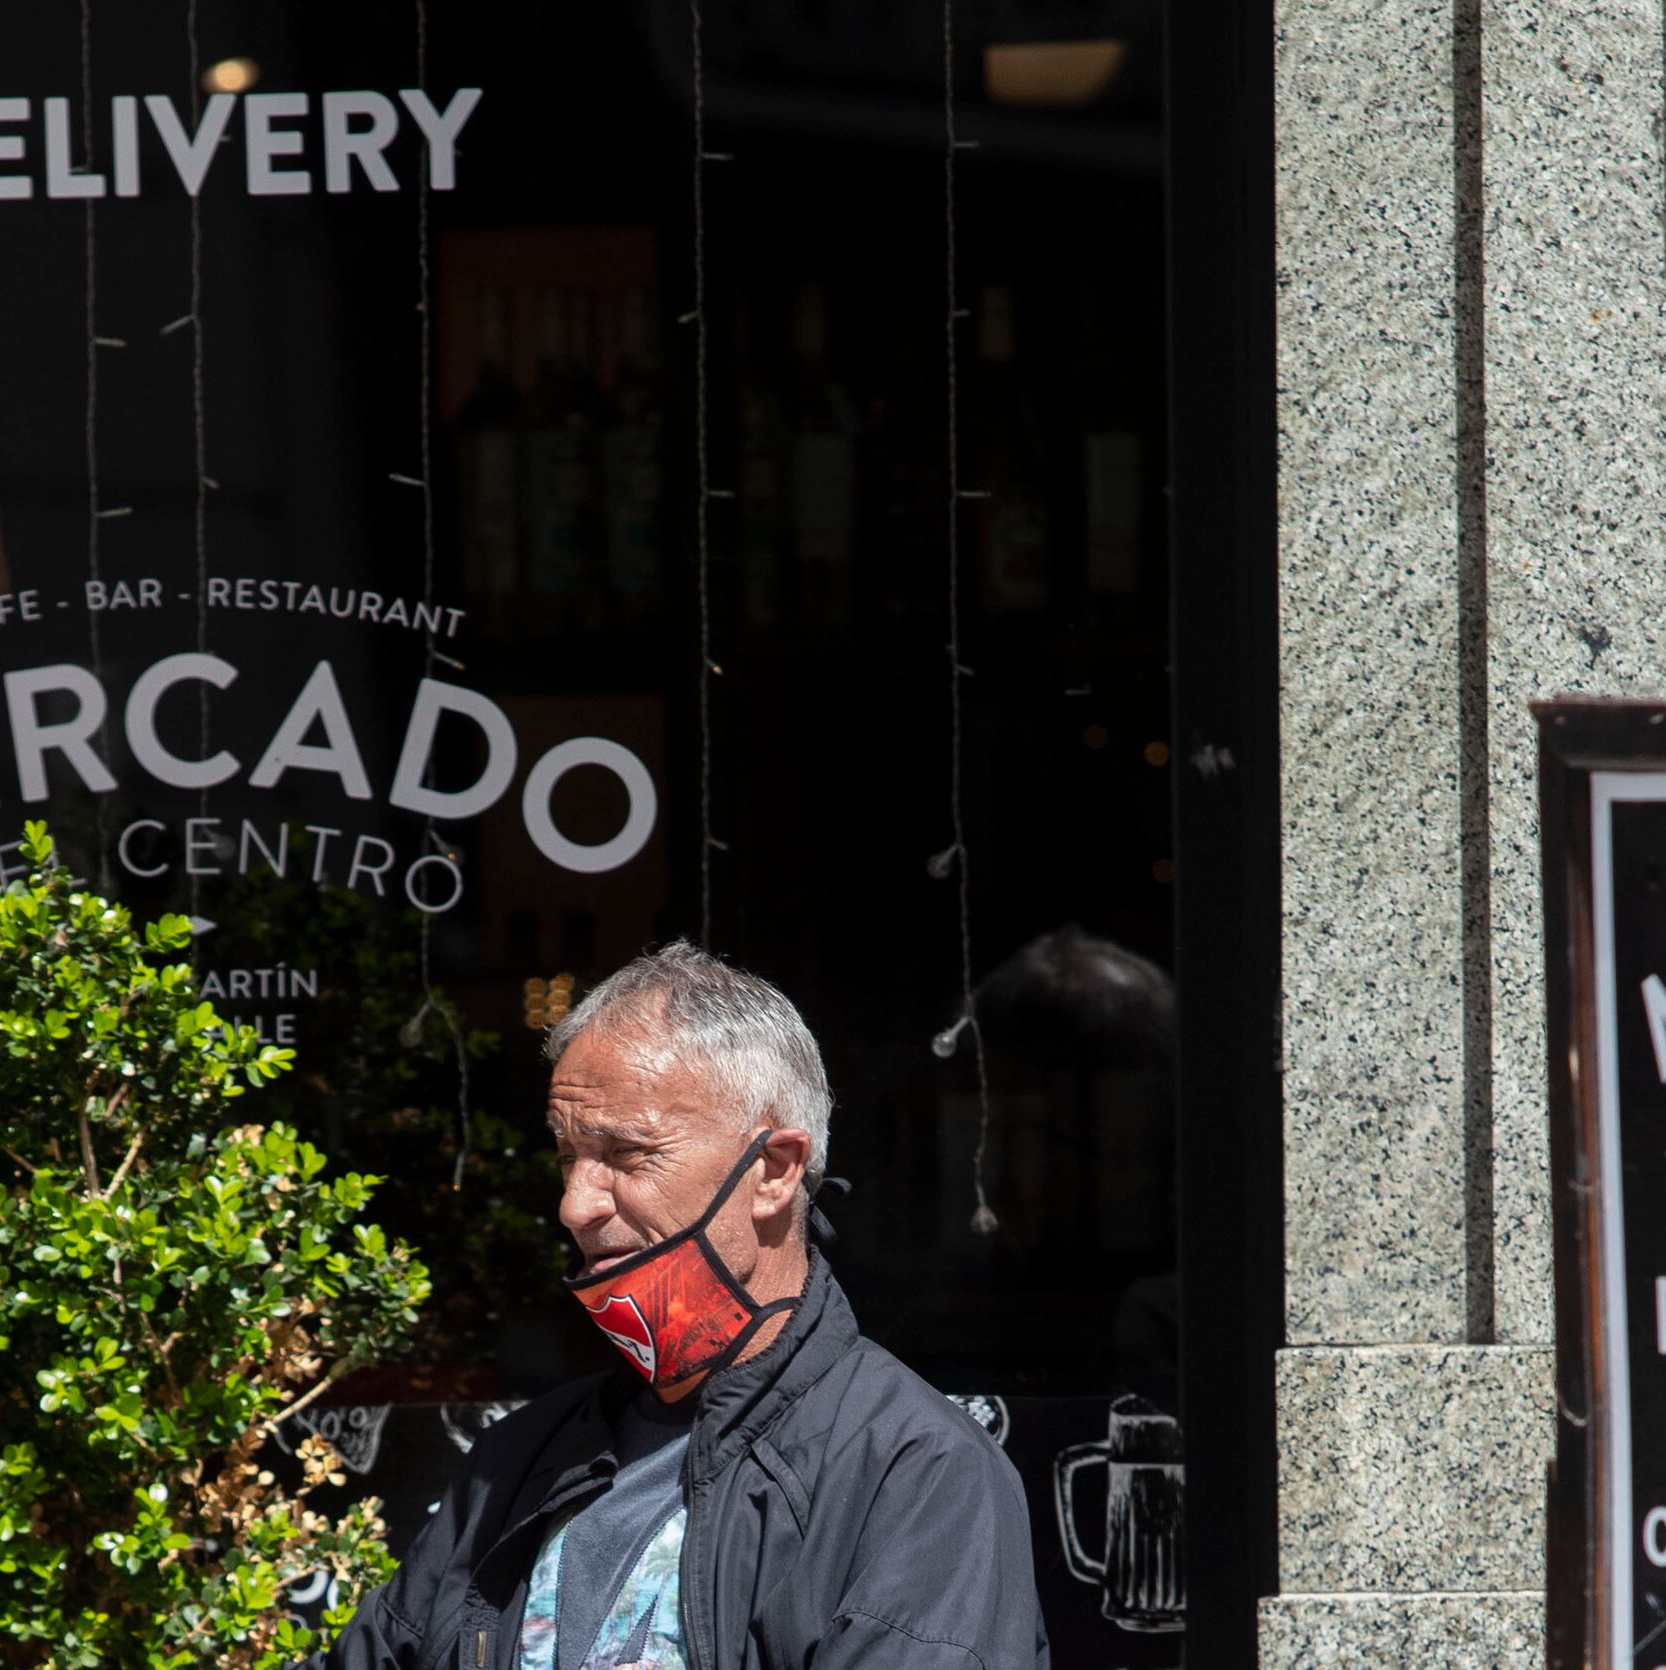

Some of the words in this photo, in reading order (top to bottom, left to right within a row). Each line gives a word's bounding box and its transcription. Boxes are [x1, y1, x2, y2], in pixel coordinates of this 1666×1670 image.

[84, 578, 163, 613] BAR
[207, 576, 467, 639] RESTAURANT
[117, 816, 464, 914] CENTRO
[199, 961, 319, 1000] ARTÍN
